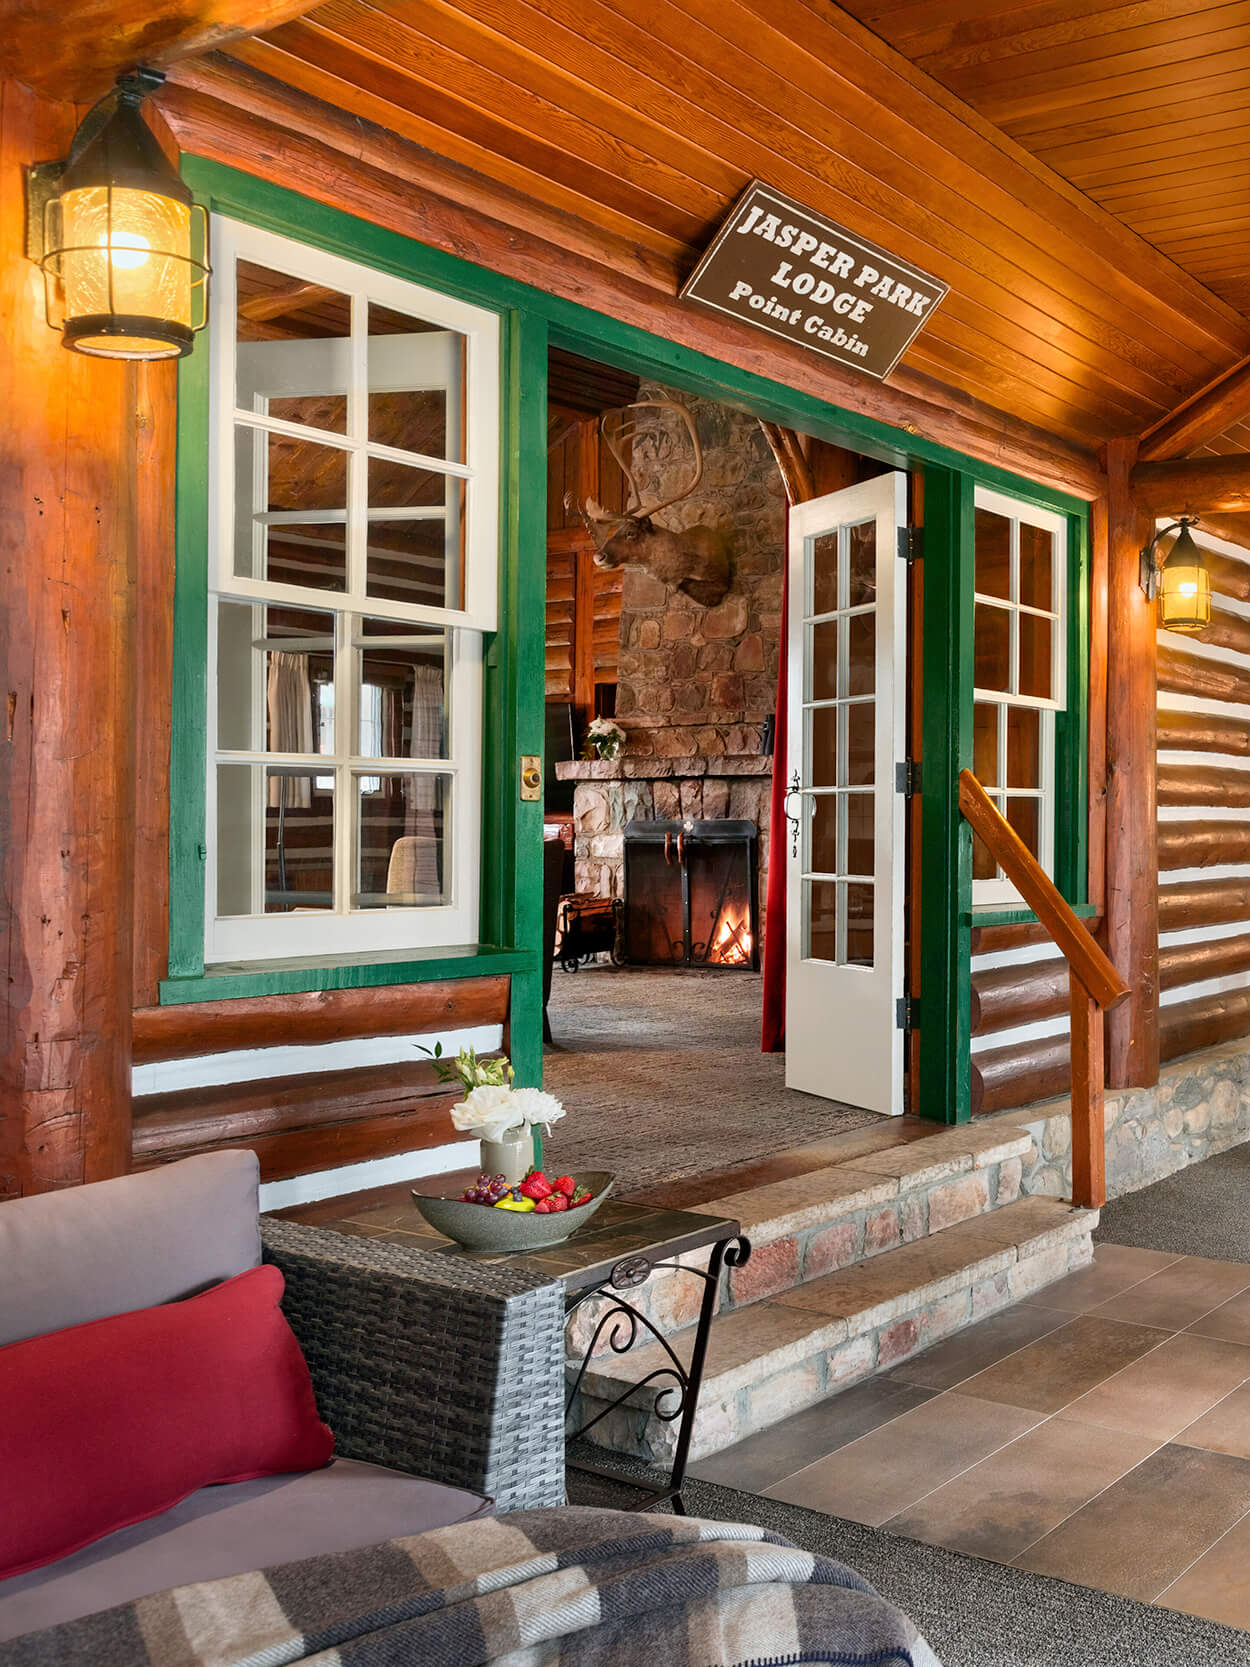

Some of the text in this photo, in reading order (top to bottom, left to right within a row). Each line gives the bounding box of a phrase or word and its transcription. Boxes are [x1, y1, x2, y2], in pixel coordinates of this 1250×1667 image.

[737, 206, 931, 317] JASPER PARK
[770, 261, 874, 324] LODGE
[728, 281, 869, 357] Point Cabin
